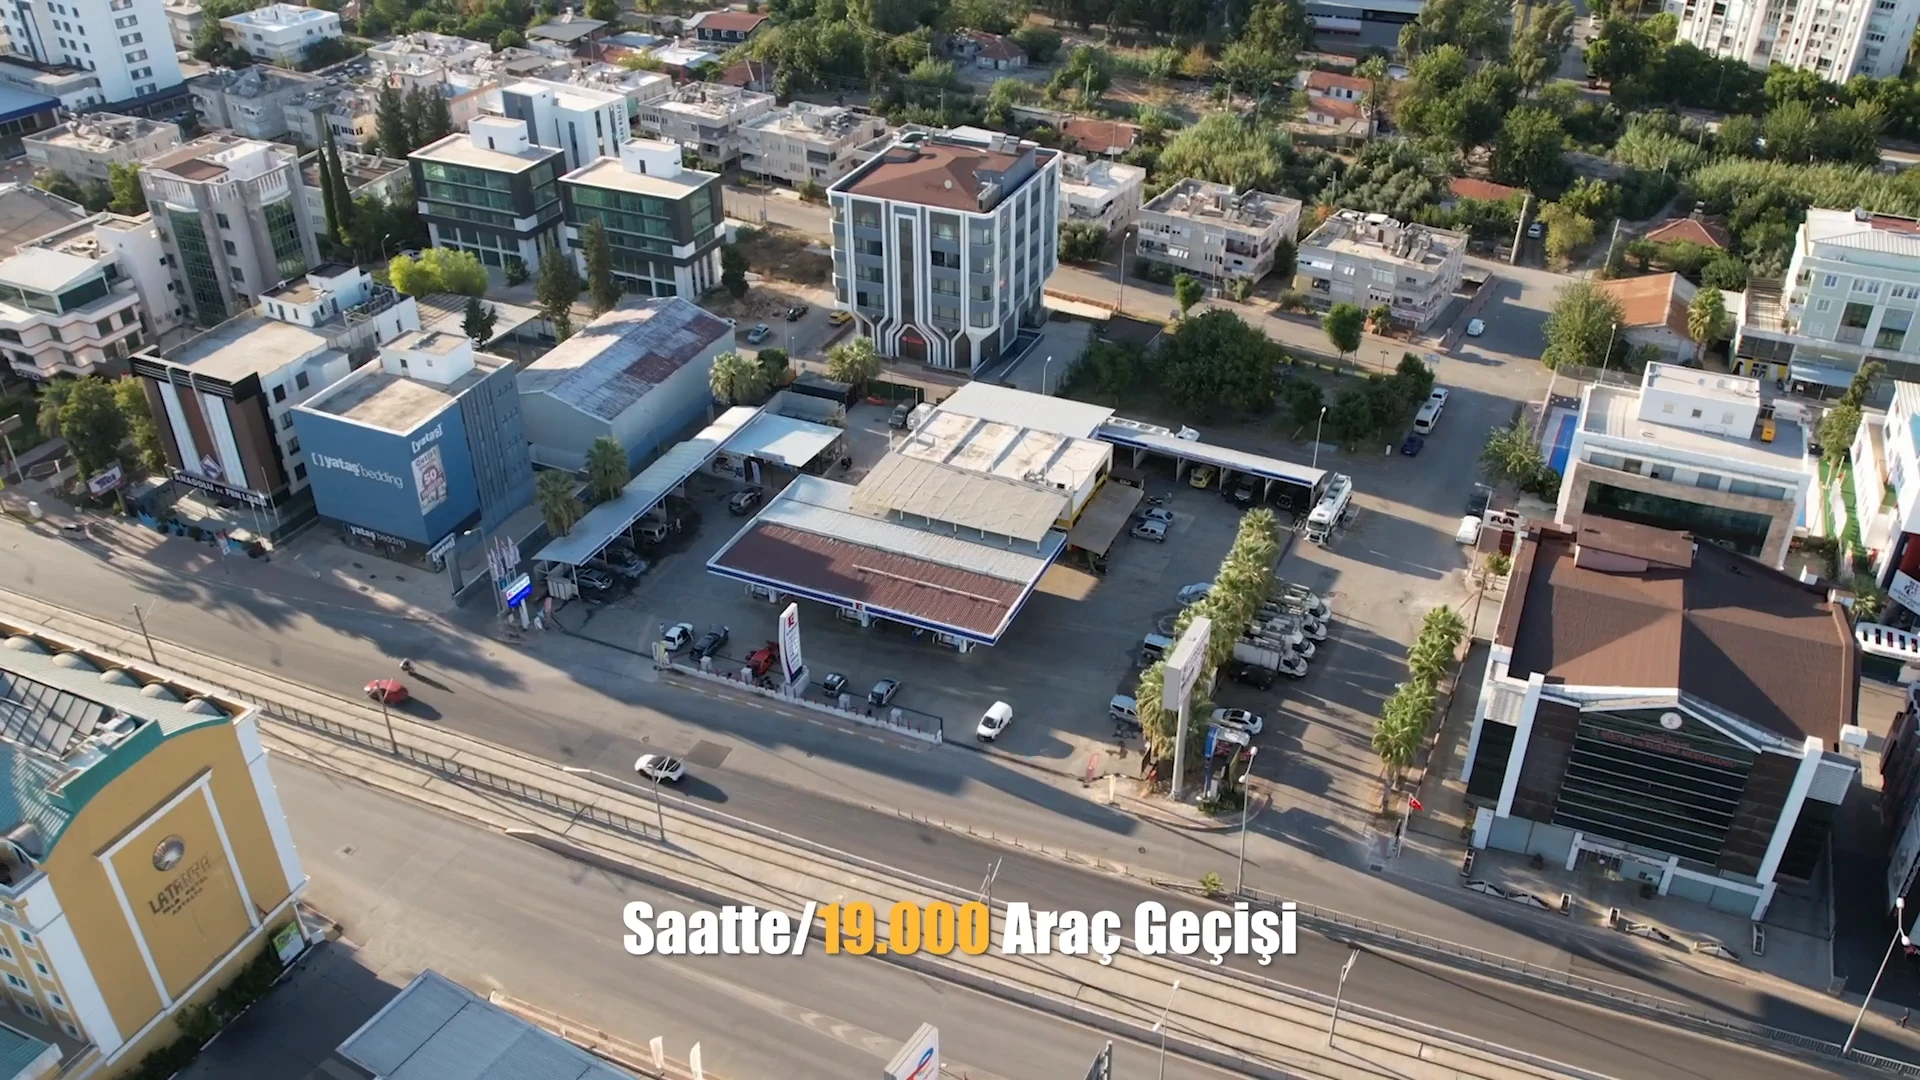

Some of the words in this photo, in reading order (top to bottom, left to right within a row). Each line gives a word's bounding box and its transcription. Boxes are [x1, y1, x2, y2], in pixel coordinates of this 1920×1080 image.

[175, 473, 214, 492] ANADOLU
[225, 488, 242, 500] FEN
[360, 465, 404, 489] bedding
[423, 467, 438, 485] 50
[376, 532, 407, 549] bedding
[148, 852, 211, 914] LATANYA
